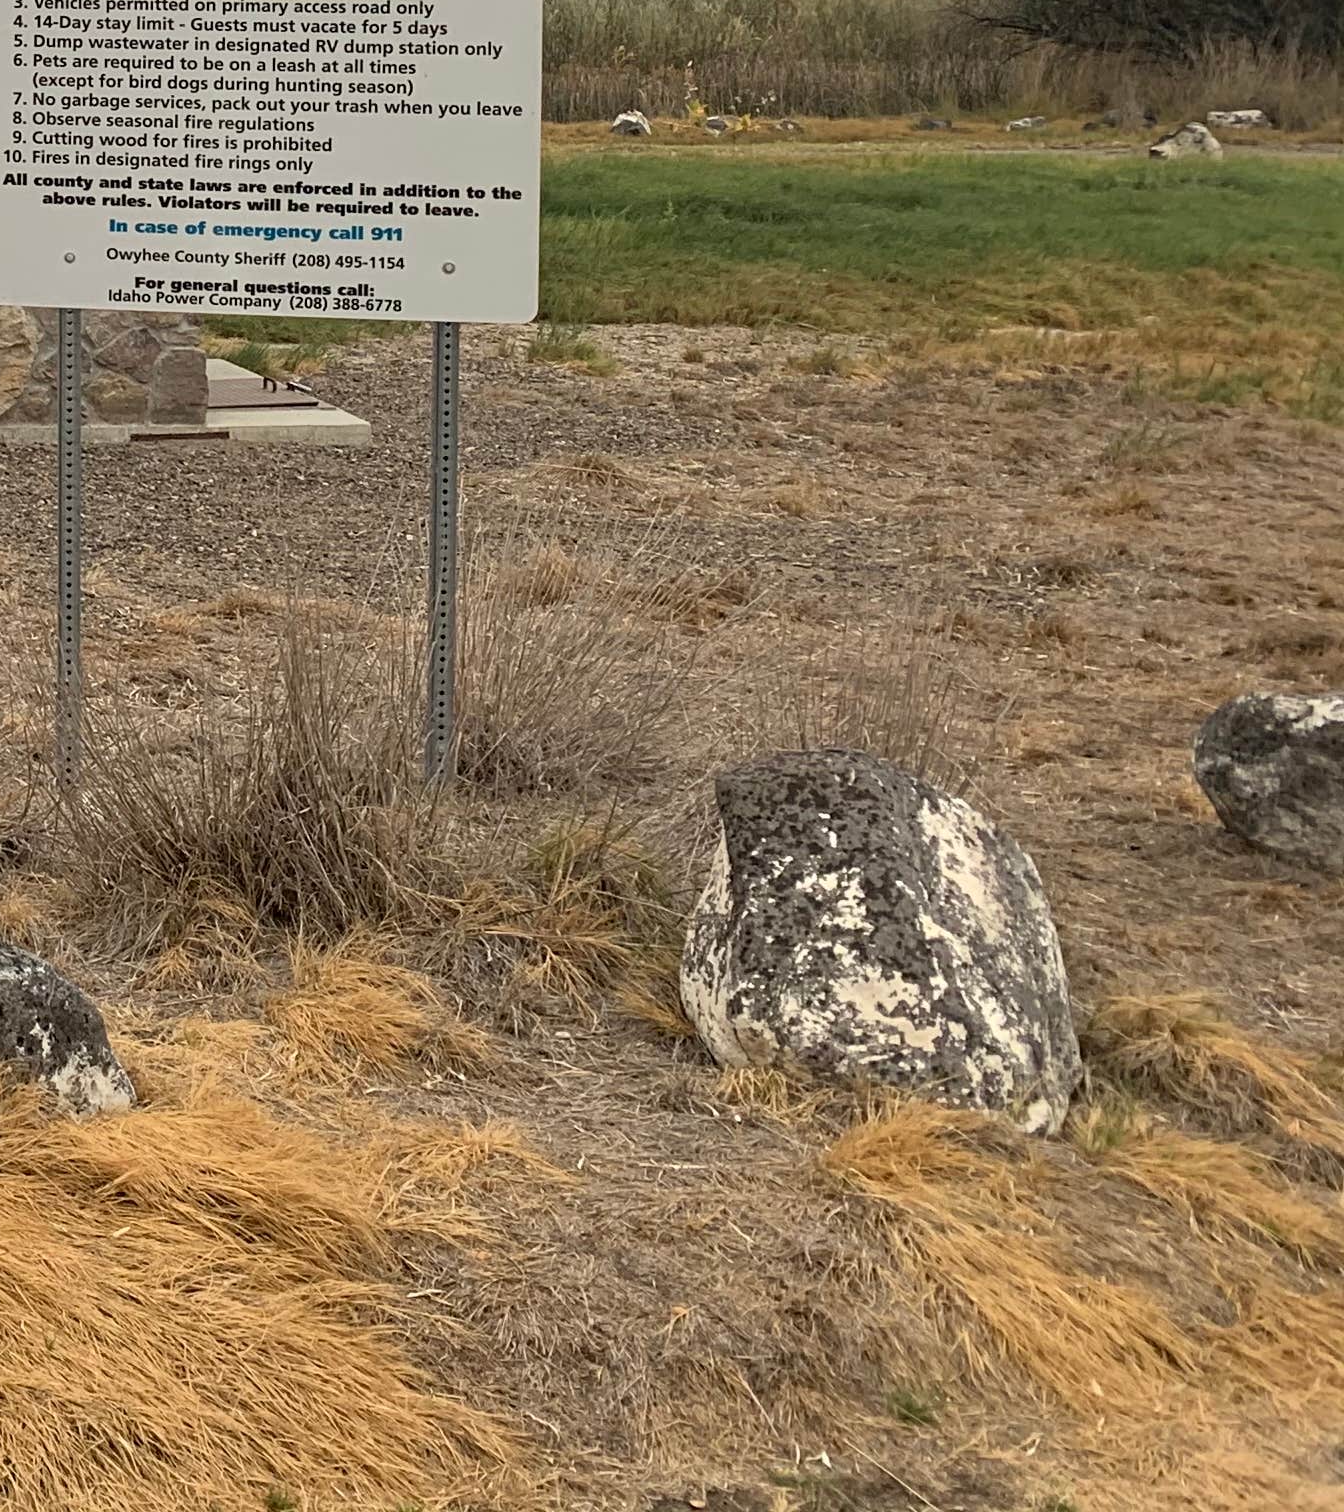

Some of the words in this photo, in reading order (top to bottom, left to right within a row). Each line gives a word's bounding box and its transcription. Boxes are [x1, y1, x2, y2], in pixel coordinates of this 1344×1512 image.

[194, 0, 216, 12] on
[293, 2, 346, 14] access
[351, 0, 391, 14] road
[395, 0, 434, 18] only
[12, 14, 28, 28] 4.
[33, 14, 92, 33] 14-Day
[95, 16, 131, 34] stay
[136, 15, 175, 31] limit
[190, 17, 248, 32] Guests
[252, 19, 296, 33] must
[299, 20, 356, 34] vacate
[360, 18, 388, 34] for
[392, 20, 402, 34] 5
[407, 19, 448, 38] days
[12, 110, 27, 125] 8.
[32, 110, 101, 127] Observe
[105, 113, 178, 128] seasonal
[183, 113, 213, 130] fire
[218, 115, 315, 133] regulations
[12, 130, 27, 144] 9.
[32, 130, 94, 149] Cutting
[98, 132, 147, 147] wood
[152, 132, 178, 148] for
[182, 133, 220, 149] fires
[225, 134, 238, 150] is
[243, 135, 332, 152] prohibited
[3, 148, 26, 163] 10.
[32, 149, 70, 164] Fires
[74, 150, 90, 165] in
[95, 150, 189, 170] designated
[194, 153, 223, 169] fire
[228, 154, 270, 173] rings
[275, 156, 313, 175] only
[109, 218, 128, 233] In
[134, 222, 178, 234] case
[184, 220, 206, 235] of
[212, 225, 322, 242] emergency
[328, 225, 364, 240] call
[370, 226, 402, 241] 911
[106, 247, 170, 264] Owyhee
[174, 249, 230, 267] County
[234, 251, 286, 266] Sheriff
[292, 252, 331, 270] (208)
[334, 255, 405, 270] 495-1154
[134, 276, 165, 291] For
[170, 279, 238, 295] general
[244, 281, 331, 297] questions
[337, 283, 375, 297] call:
[108, 289, 151, 303] Idaho
[155, 290, 205, 305] Power
[208, 292, 282, 311] Company
[288, 293, 328, 312] (208)
[332, 294, 402, 312] 388-6778
